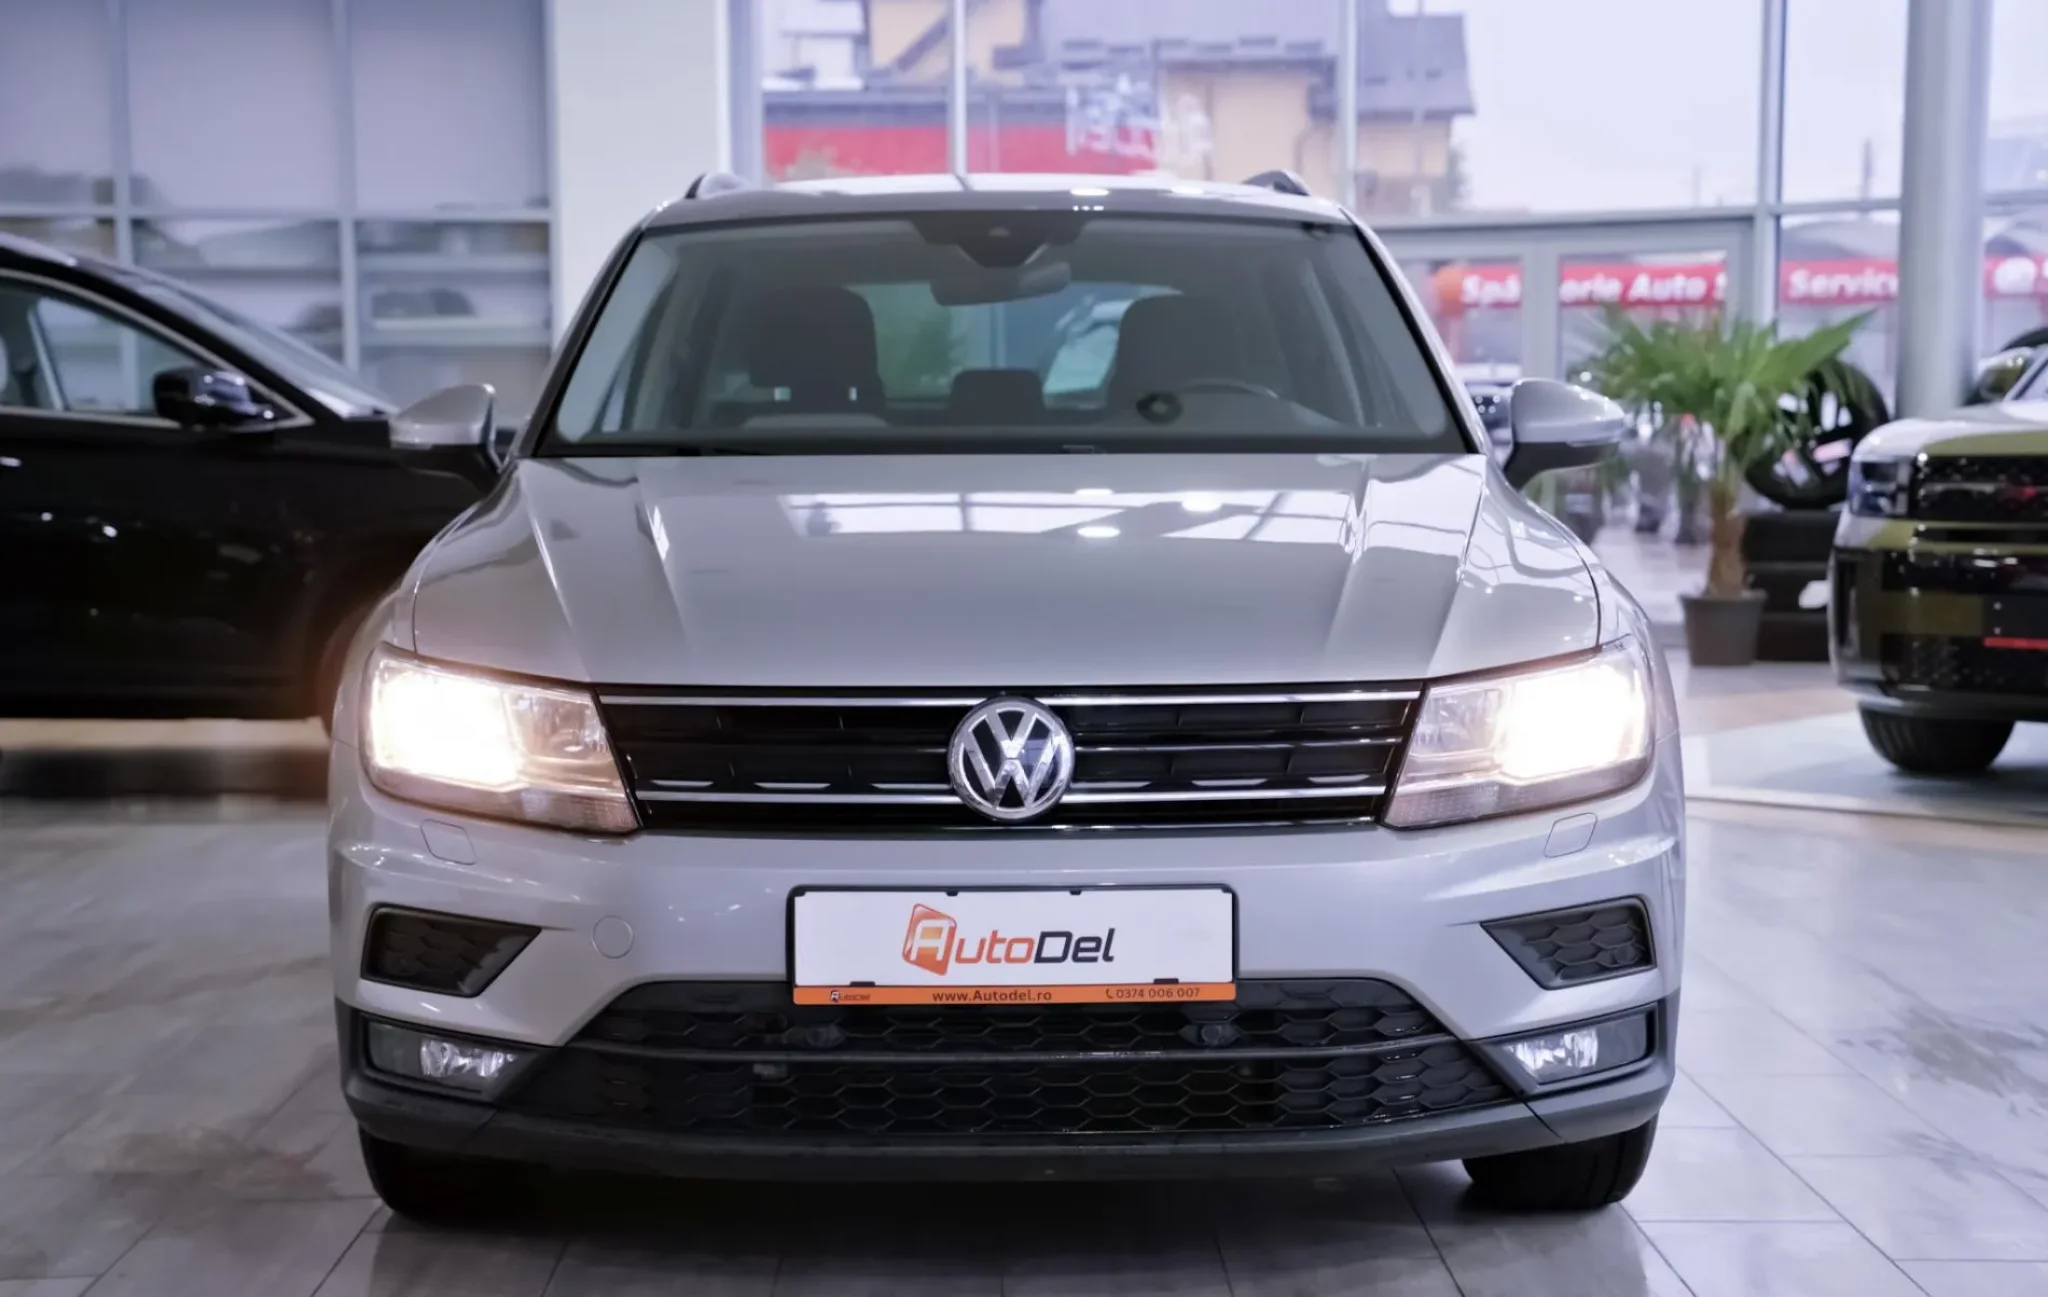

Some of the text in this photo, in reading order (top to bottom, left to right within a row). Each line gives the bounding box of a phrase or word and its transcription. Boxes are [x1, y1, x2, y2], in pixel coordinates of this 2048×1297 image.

[1628, 272, 1708, 301] Auto
[1788, 267, 1899, 299] Servic
[954, 699, 1068, 814] VW
[906, 915, 1116, 966] AutoDel
[931, 988, 1053, 1002] www.Autodel.ro
[1115, 987, 1200, 999] 0374 006 007
